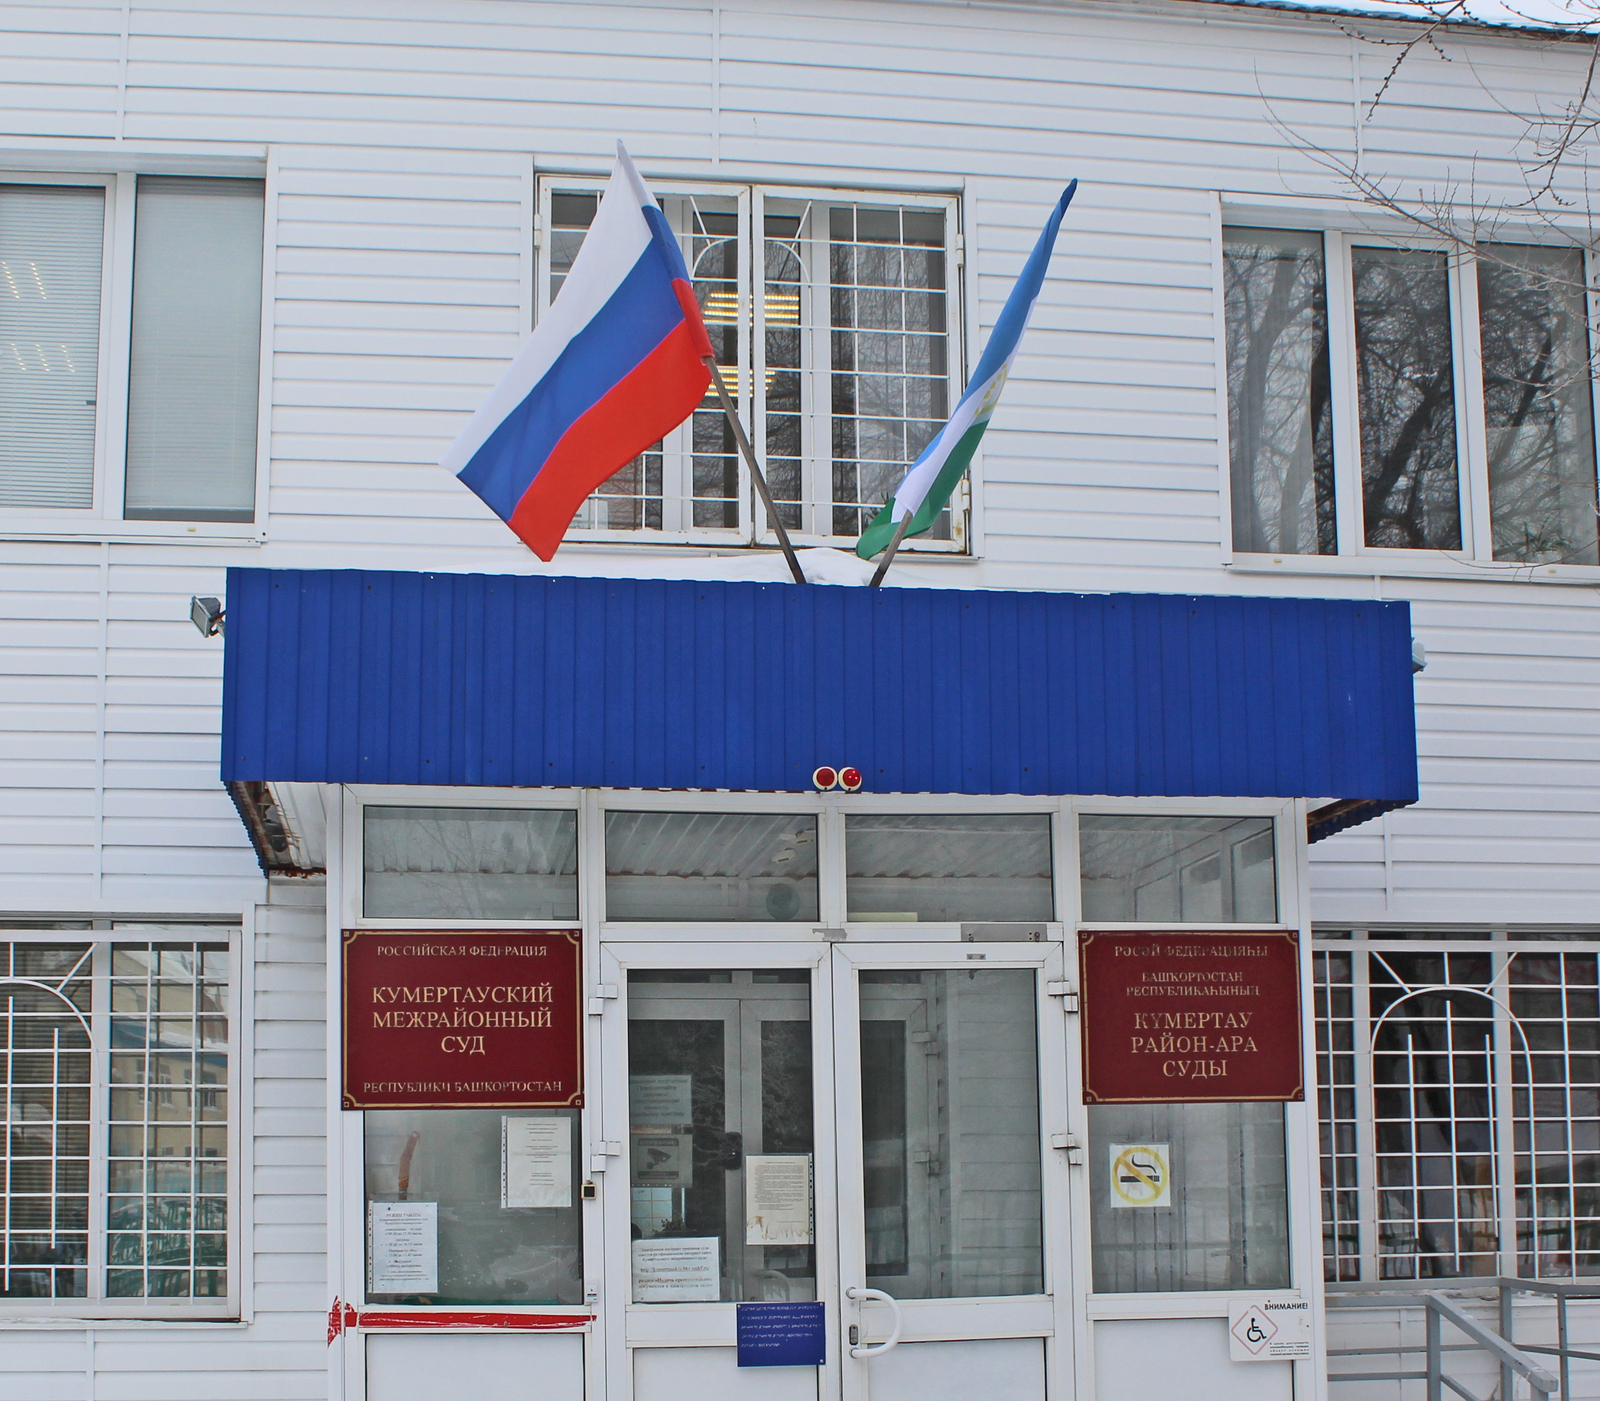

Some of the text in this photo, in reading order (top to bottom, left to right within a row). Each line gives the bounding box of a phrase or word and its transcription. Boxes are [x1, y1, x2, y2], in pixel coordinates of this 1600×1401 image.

[377, 943, 466, 956] РОССИЙСКАЯ
[372, 982, 553, 1003] КУМЕРТАУСКИЙ
[372, 1007, 552, 1028] МЕЖРАЙОННЫЙ
[1135, 1012, 1253, 1029] КҮМЕРТАУ
[441, 1036, 485, 1055] СУД
[1131, 1033, 1258, 1053] РАЙОН-АРА
[1163, 1060, 1228, 1080] СУДЫ
[363, 1081, 562, 1093] РЕСПУБЛИКИ БАШКОРТОСТАН
